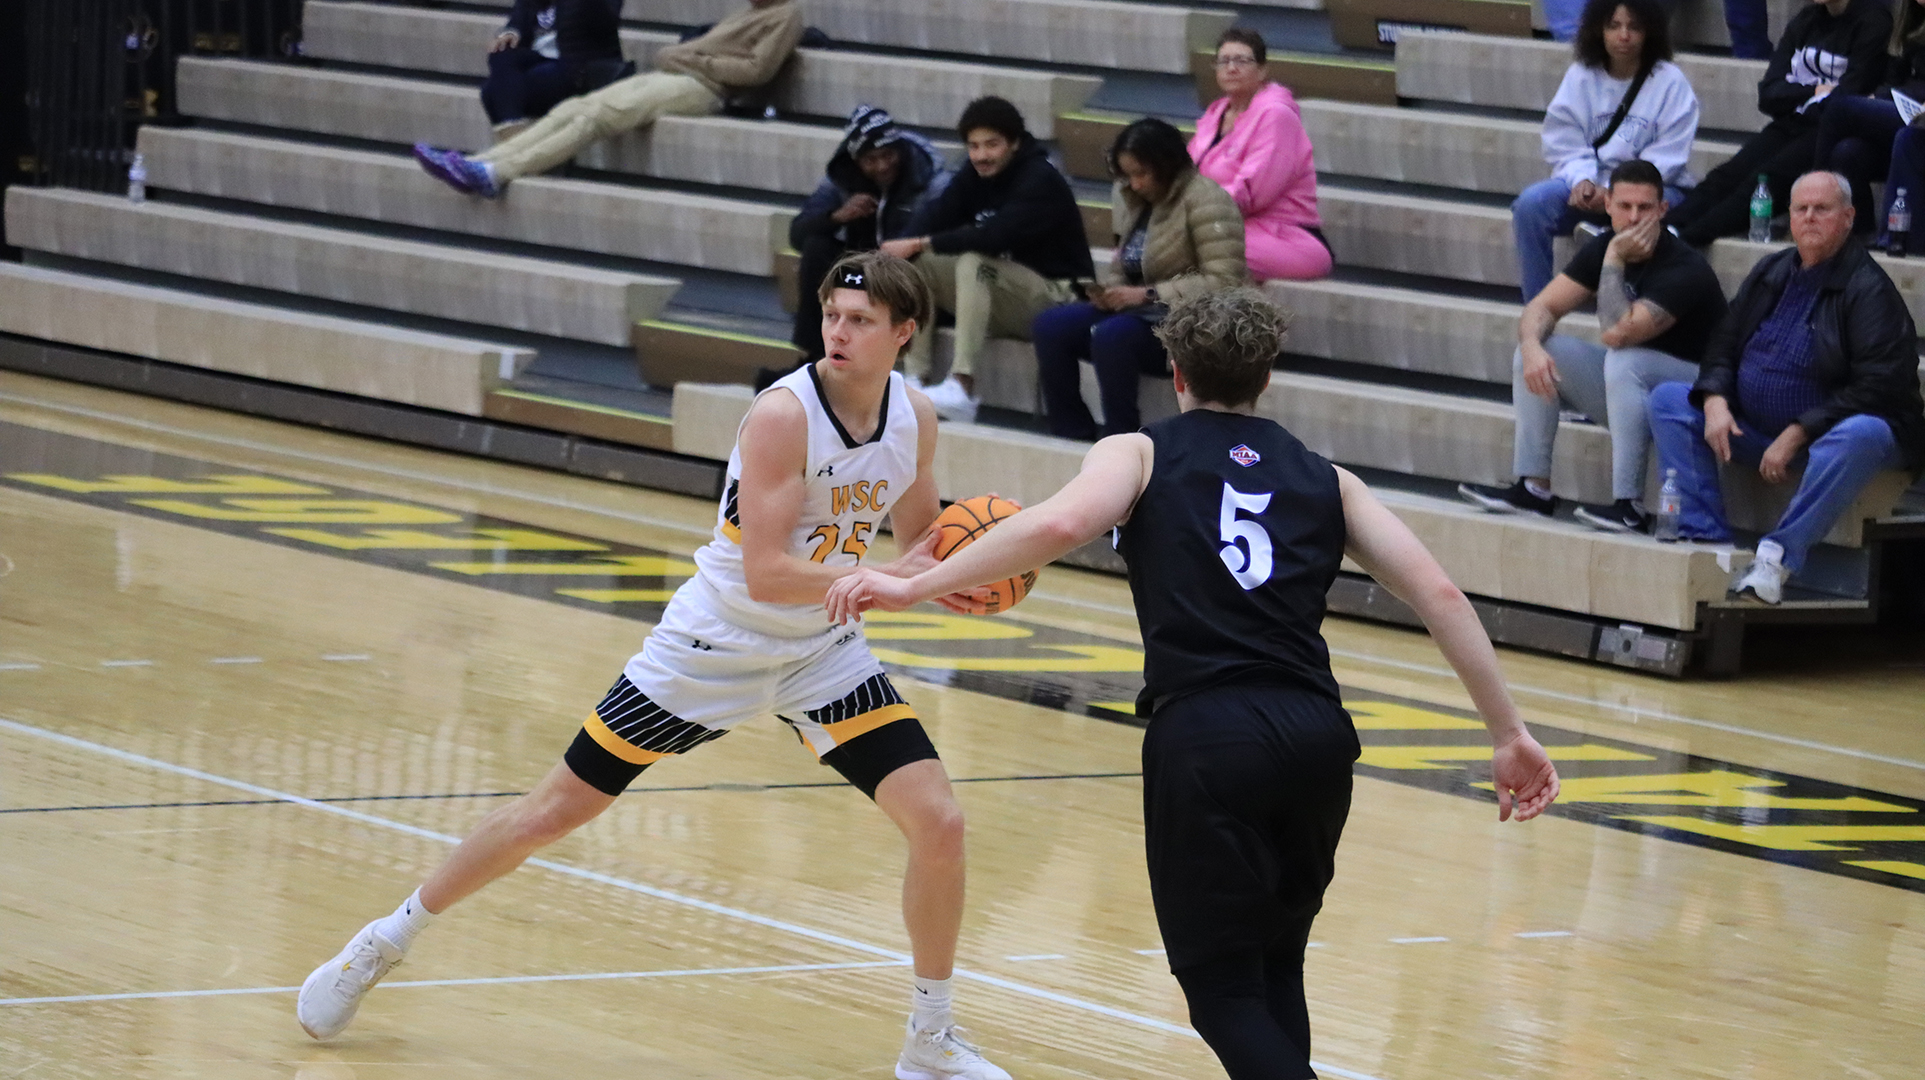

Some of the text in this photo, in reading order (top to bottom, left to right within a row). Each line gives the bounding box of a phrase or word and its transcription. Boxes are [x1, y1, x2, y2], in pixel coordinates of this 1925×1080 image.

[1231, 451, 1258, 460] MIAA
[831, 479, 888, 516] WSC
[805, 521, 872, 566] 25
[1219, 482, 1273, 591] 5
